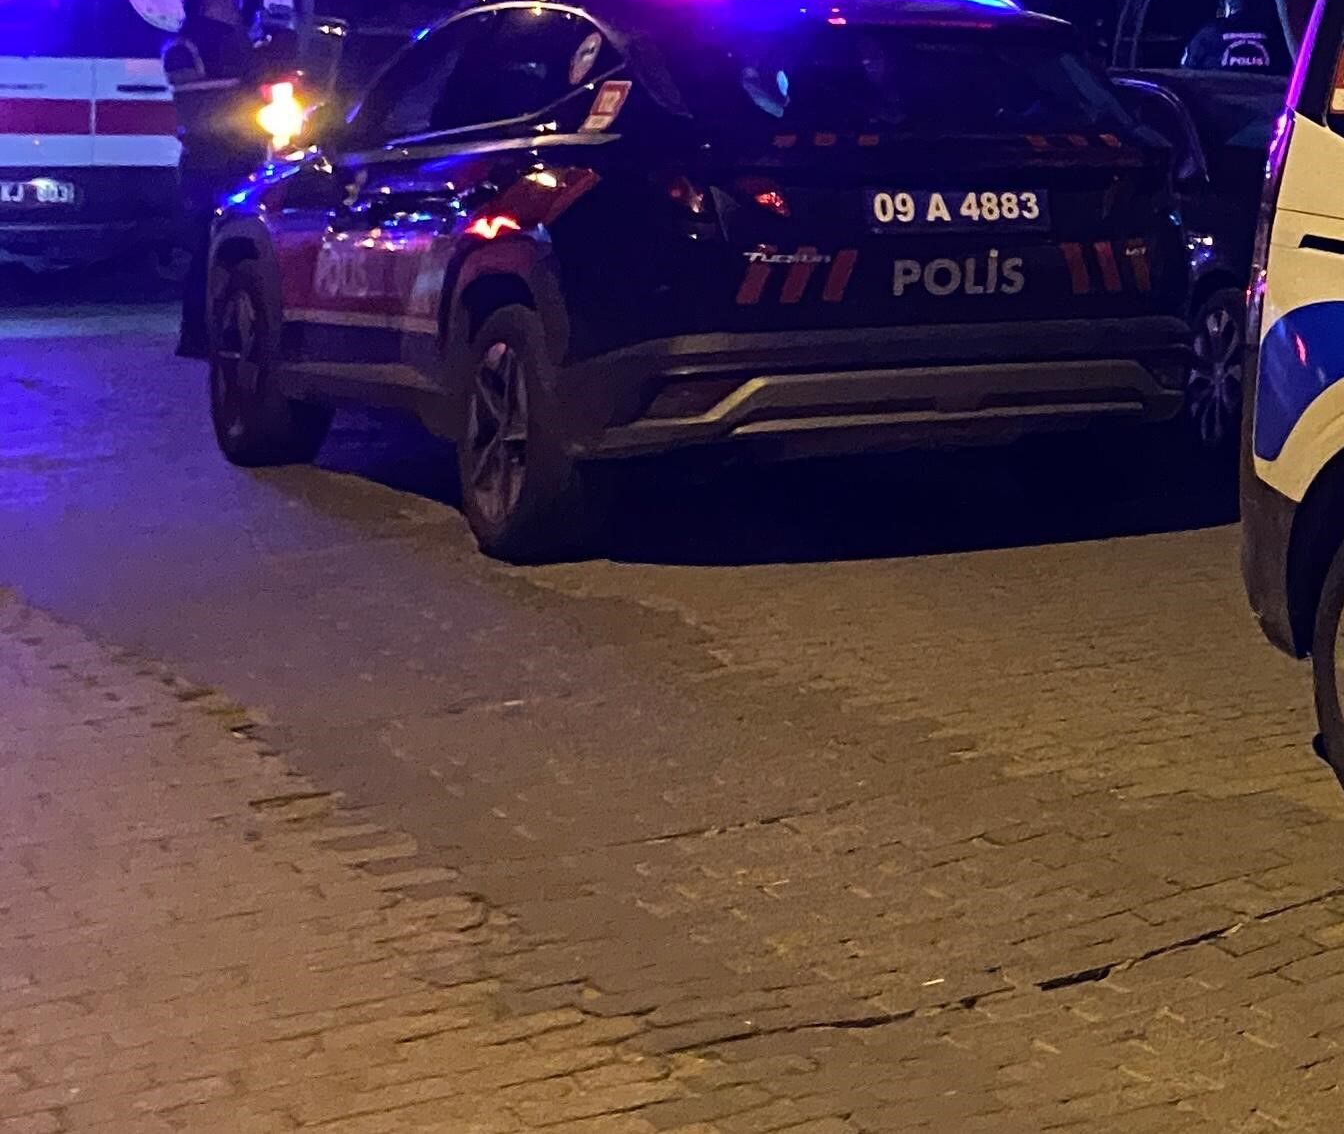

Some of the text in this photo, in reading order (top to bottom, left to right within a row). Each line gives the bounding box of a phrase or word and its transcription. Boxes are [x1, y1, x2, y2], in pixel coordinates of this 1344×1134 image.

[874, 191, 1040, 222] 09 A 4883
[893, 248, 1025, 296] POLİS
